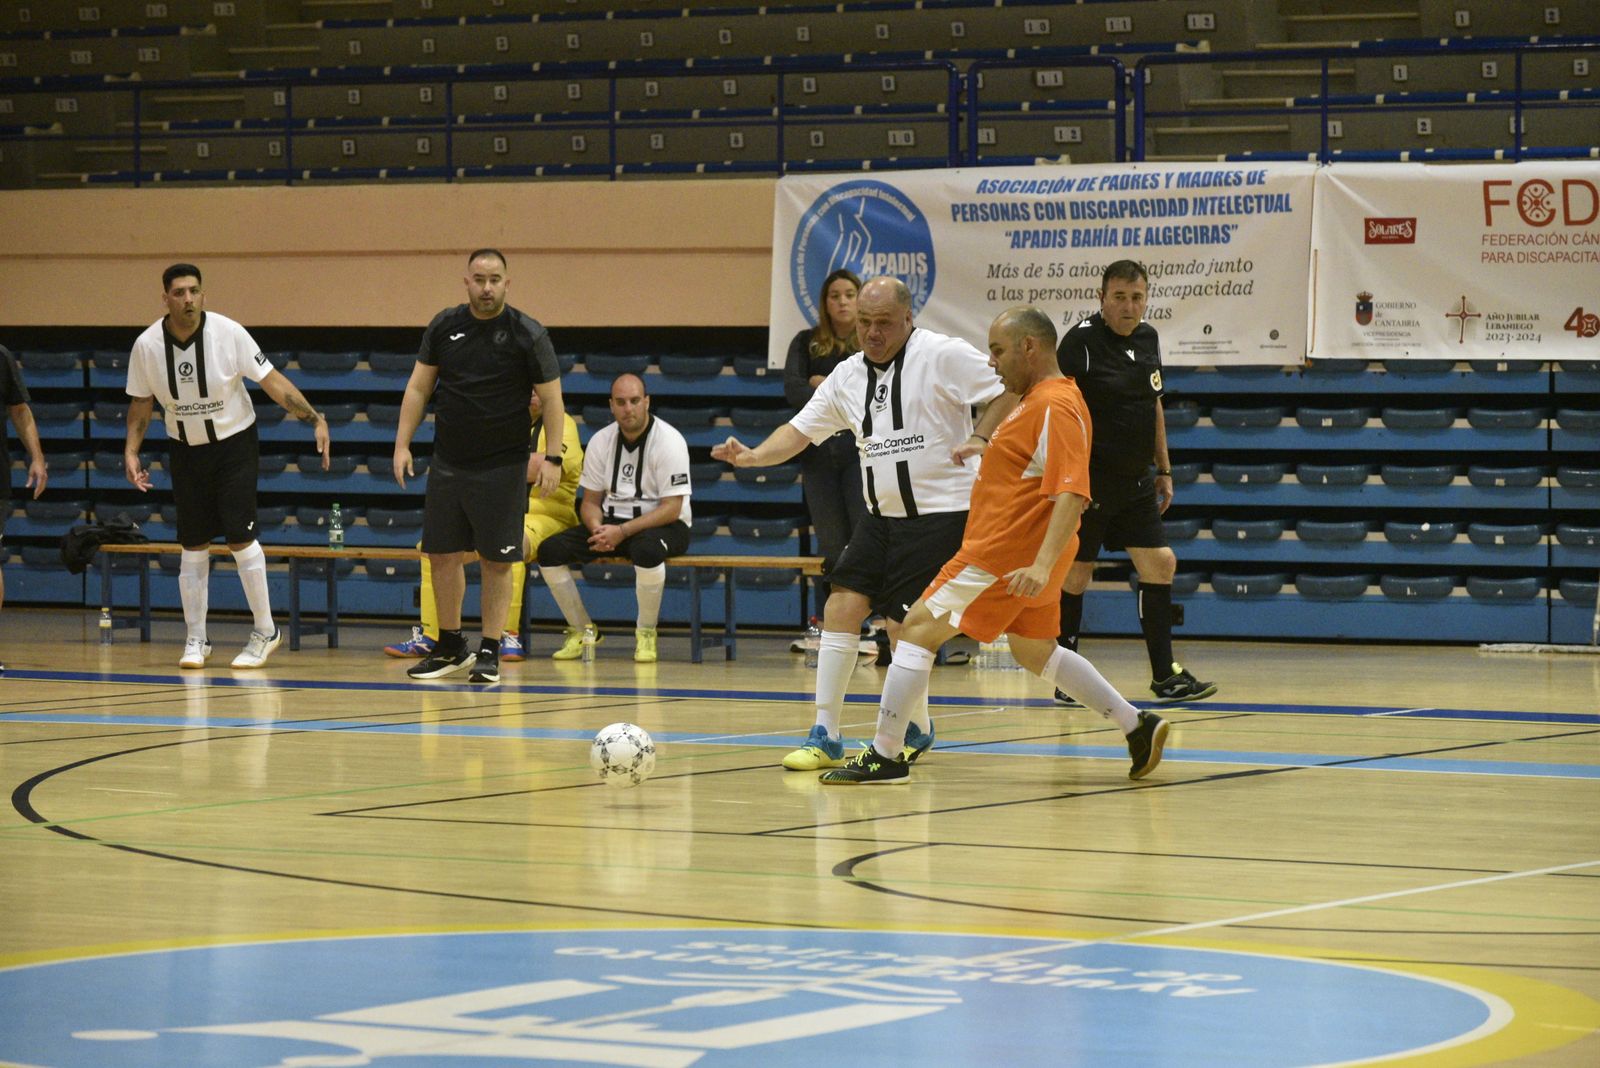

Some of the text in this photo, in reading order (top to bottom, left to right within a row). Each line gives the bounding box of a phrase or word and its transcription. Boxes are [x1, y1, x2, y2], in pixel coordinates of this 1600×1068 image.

[1028, 22, 1046, 33] 10
[1109, 18, 1127, 31] 11
[1192, 17, 1210, 28] 12
[1040, 74, 1058, 85] 11
[891, 132, 912, 144] 10
[1058, 128, 1078, 140] 12
[976, 169, 1268, 194] ASOCIACIÓN DE PADRES Y MADRES DE
[951, 193, 1293, 222] PERSONAS CON DISCAPACIDAD INTELECTUAL
[1071, 224, 1118, 248] BAHÍA
[1121, 227, 1141, 247] DE
[1368, 220, 1413, 239] SOLARES
[1481, 231, 1568, 246] FEDERACIÓN
[862, 252, 928, 275] APADIS
[1481, 251, 1515, 264] PARA
[986, 257, 1254, 279] Más de 55 años bajando junto
[986, 288, 997, 301] a
[1001, 286, 1024, 301] las
[1027, 286, 1102, 304] personas
[1375, 301, 1418, 311] GOBIERNO
[1062, 310, 1074, 325] y
[1375, 319, 1421, 328] CANTABRIA
[1486, 311, 1541, 323] AÑO JUBILAR
[1485, 321, 1534, 331] LEBANIEGO
[192, 400, 224, 411] Canaria
[864, 434, 924, 452] Gran Canaria
[900, 444, 925, 453] Deporte
[552, 946, 1258, 998] Ayuntamiento
